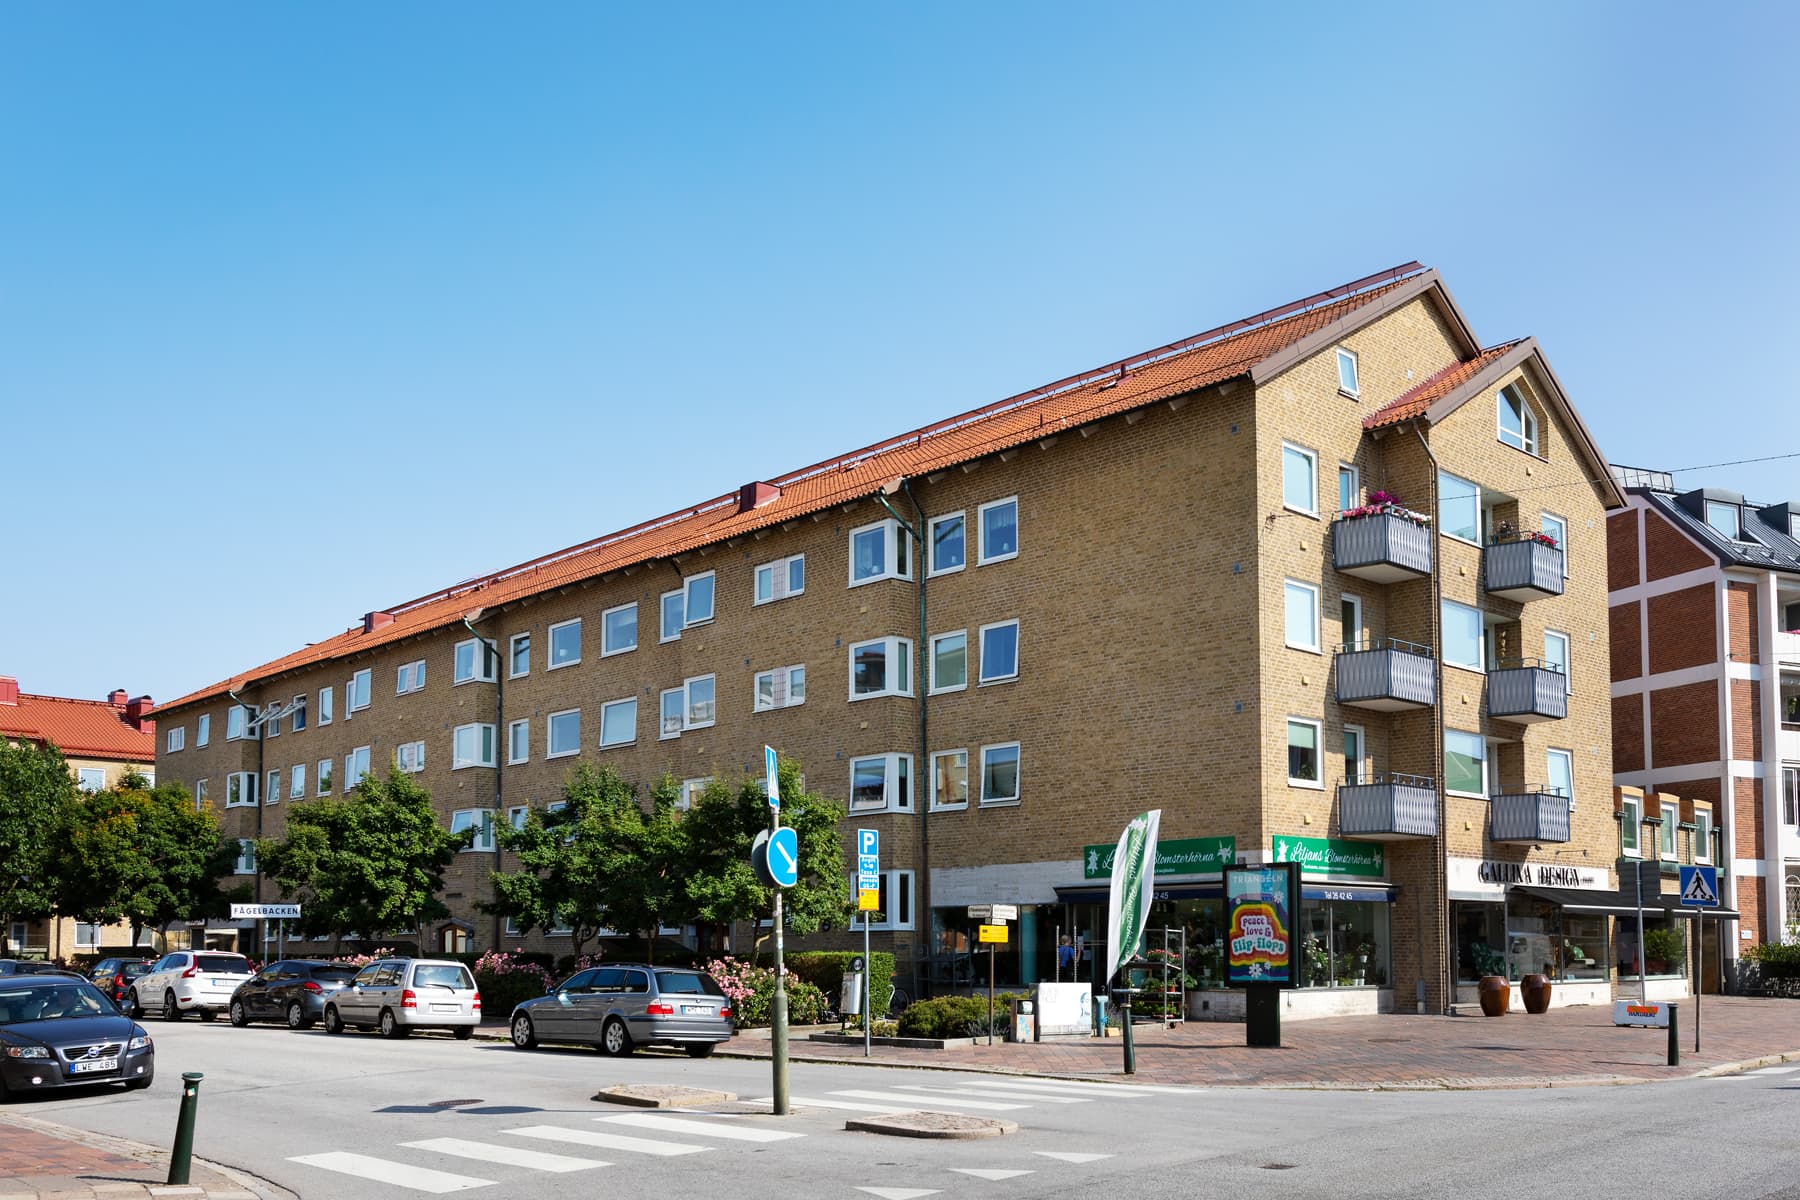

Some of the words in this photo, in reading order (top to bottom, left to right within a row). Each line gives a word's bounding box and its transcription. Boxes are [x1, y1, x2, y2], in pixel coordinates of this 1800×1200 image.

[863, 832, 875, 854] P
[1290, 841, 1323, 866] Liljans
[1232, 873, 1284, 884] TRIANGELN
[1478, 861, 1532, 884] GALLINA
[1538, 866, 1580, 887] DESIGN
[1160, 891, 1169, 900] 45
[233, 906, 299, 915] FÅGELBACKEN
[1242, 917, 1265, 927] peace
[1246, 926, 1263, 936] love
[1264, 928, 1272, 938] &
[1232, 937, 1285, 953] flip-flops
